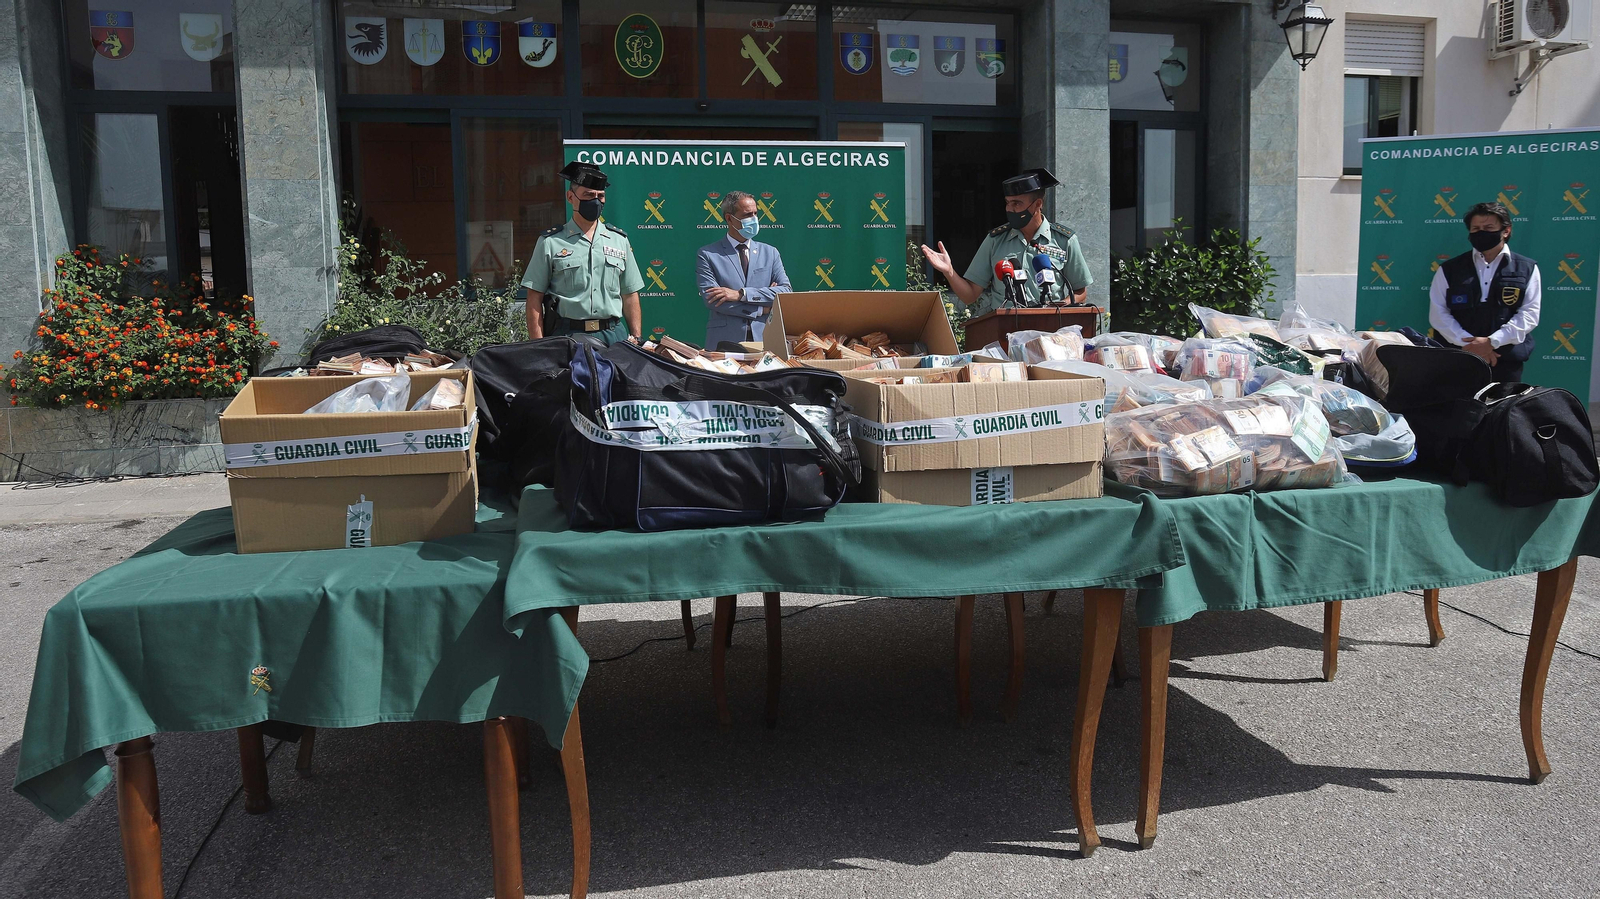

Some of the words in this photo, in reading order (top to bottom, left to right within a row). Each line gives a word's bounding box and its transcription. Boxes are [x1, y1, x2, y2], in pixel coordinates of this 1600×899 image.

[576, 150, 736, 166] COMANDANCIA
[741, 151, 768, 166] DE
[773, 151, 890, 167] ALGECIRAS
[1370, 148, 1479, 161] COMANDANCIA
[1483, 145, 1503, 156] DE
[1506, 141, 1600, 155] ALGECIRAS
[941, 356, 950, 366] 20
[606, 404, 669, 422] GUARDIA
[973, 413, 1028, 435] GUARDIA
[1030, 409, 1062, 428] CIVIL
[702, 416, 738, 435] CIVIL
[862, 423, 898, 442] GUARDIA
[902, 424, 936, 440] CIVIL
[274, 442, 340, 461] GUARDIA
[344, 439, 382, 455] CIVIL
[1242, 455, 1251, 464] 50
